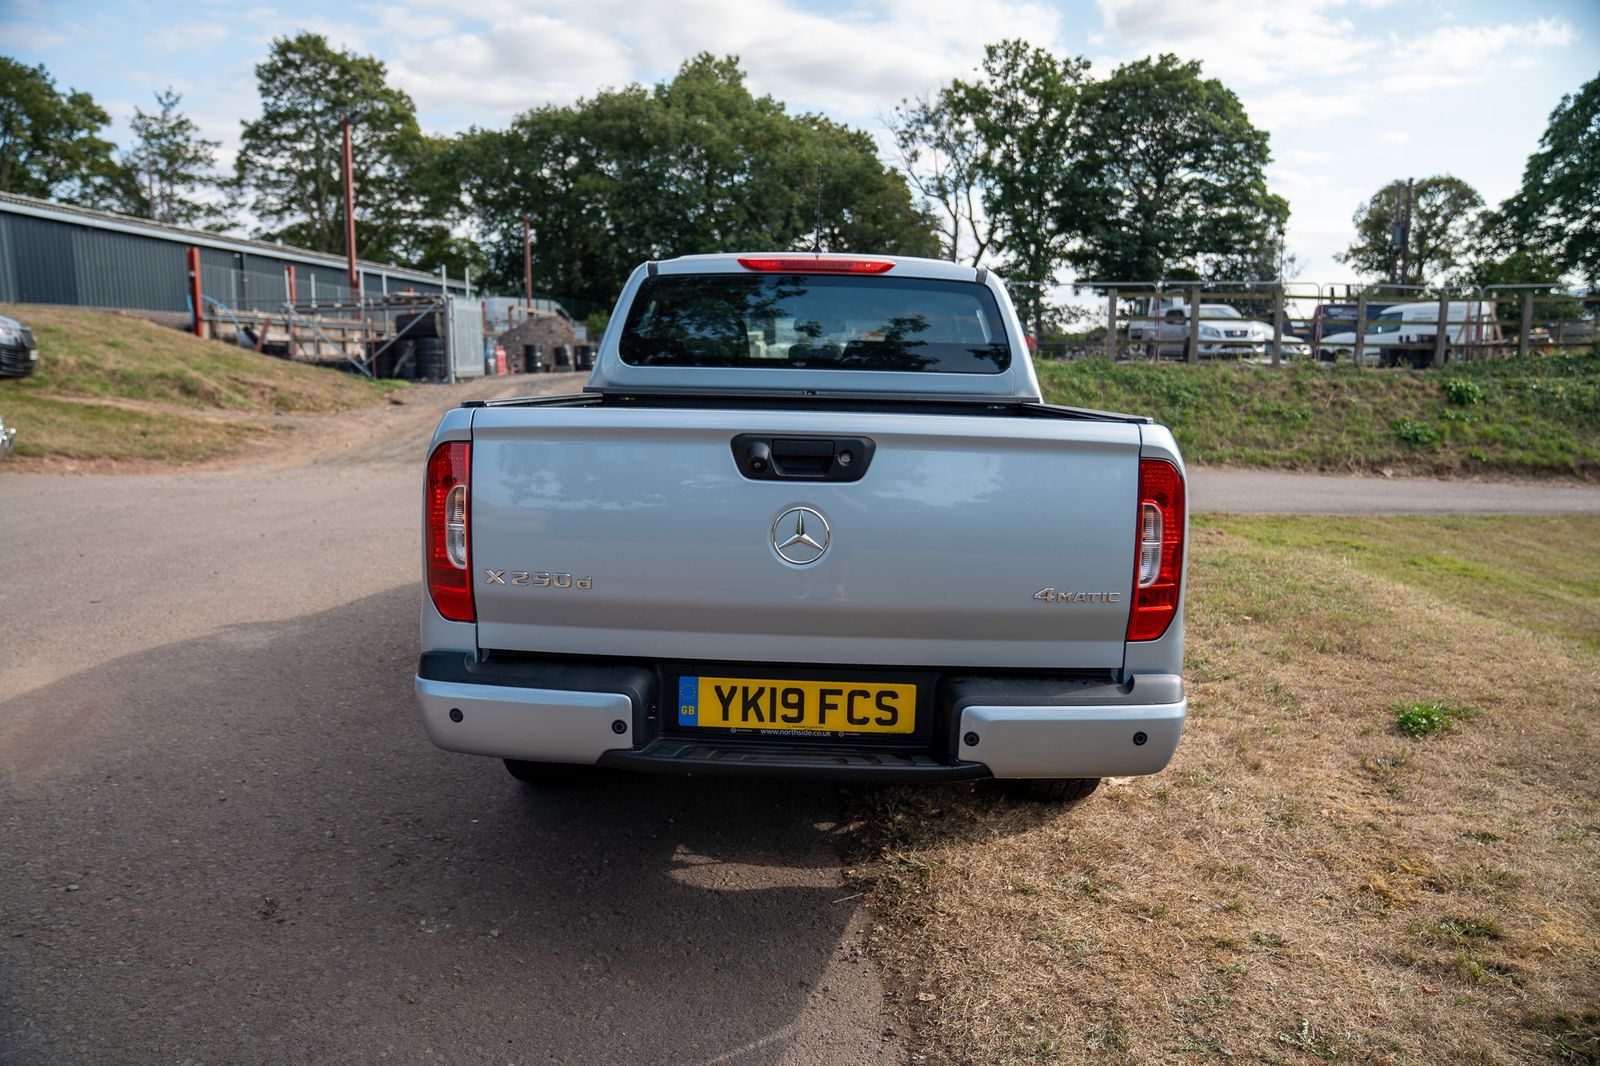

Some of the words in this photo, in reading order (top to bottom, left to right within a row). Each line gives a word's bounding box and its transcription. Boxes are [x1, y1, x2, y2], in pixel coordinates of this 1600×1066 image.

[484, 569, 506, 585] X
[511, 571, 573, 588] 250
[1033, 587, 1121, 603] 4MATIC
[681, 705, 695, 716] GB
[714, 685, 805, 724] YK19
[818, 688, 899, 727] FCS
[760, 728, 832, 737] www.northside.co.uk
